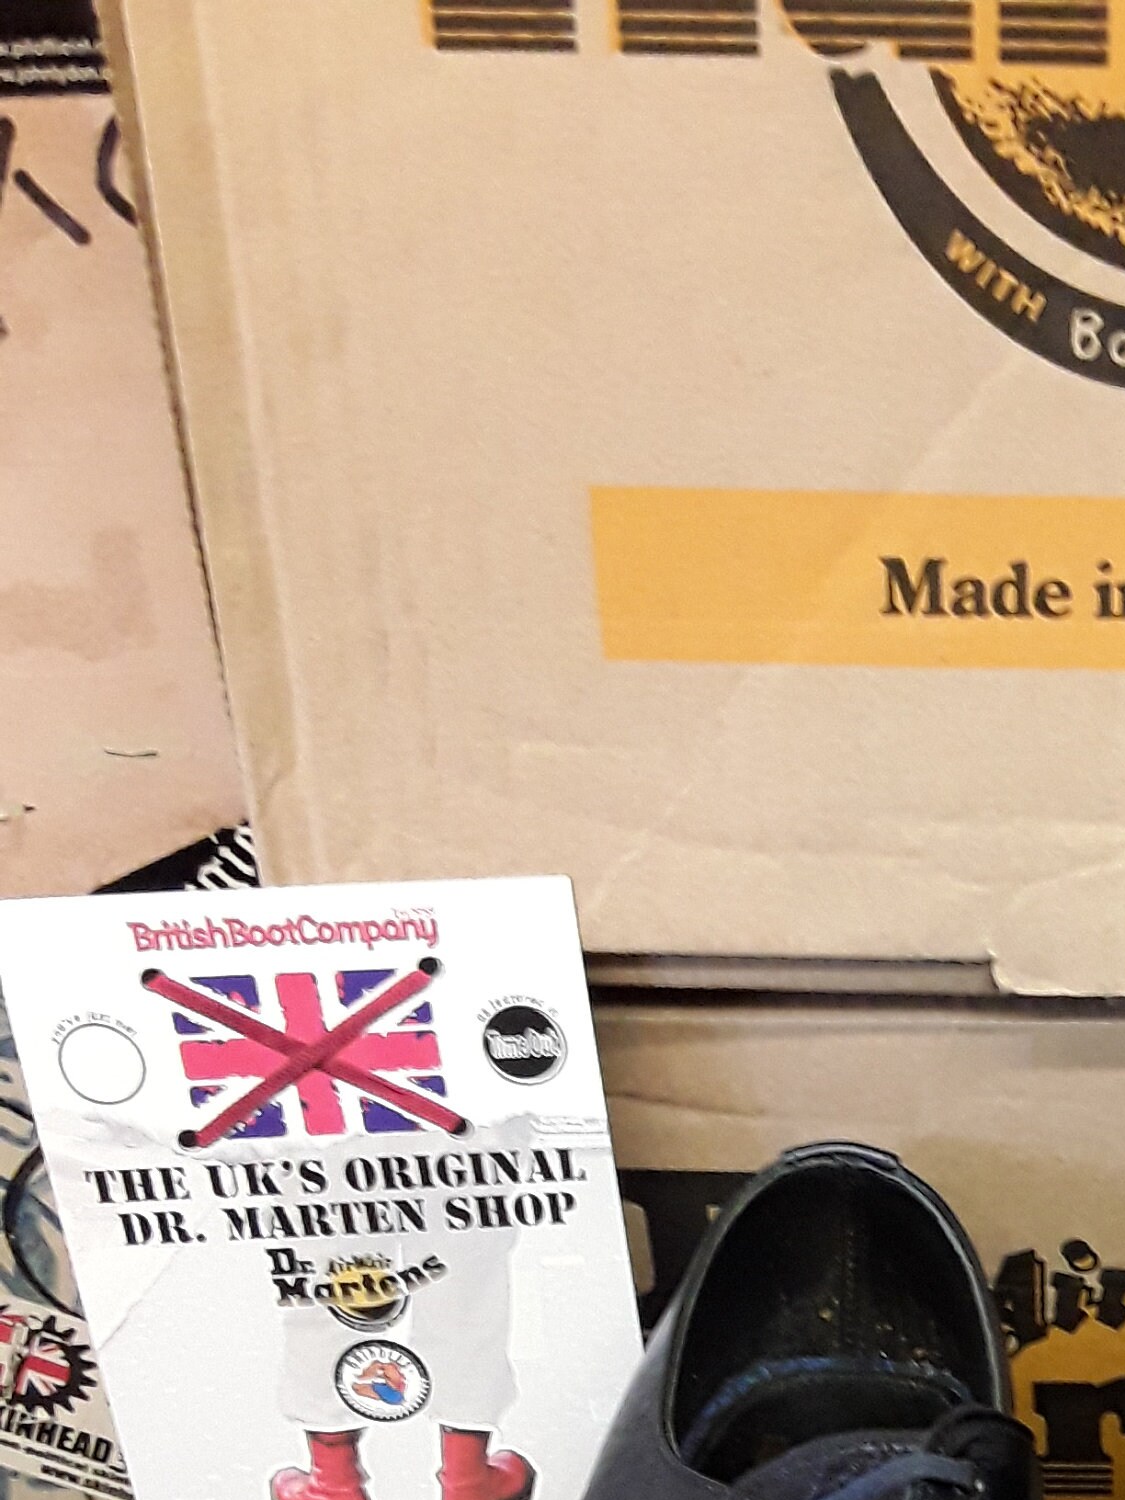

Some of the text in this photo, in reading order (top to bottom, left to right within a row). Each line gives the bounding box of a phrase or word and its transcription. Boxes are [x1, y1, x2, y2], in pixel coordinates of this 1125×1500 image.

[945, 229, 1047, 324] WITH
[878, 555, 1071, 622] Made
[84, 1147, 588, 1204] THE UK'S ORIGINAL
[118, 1192, 578, 1247] DR. MARTEN SHOP
[272, 1254, 449, 1307] Martens
